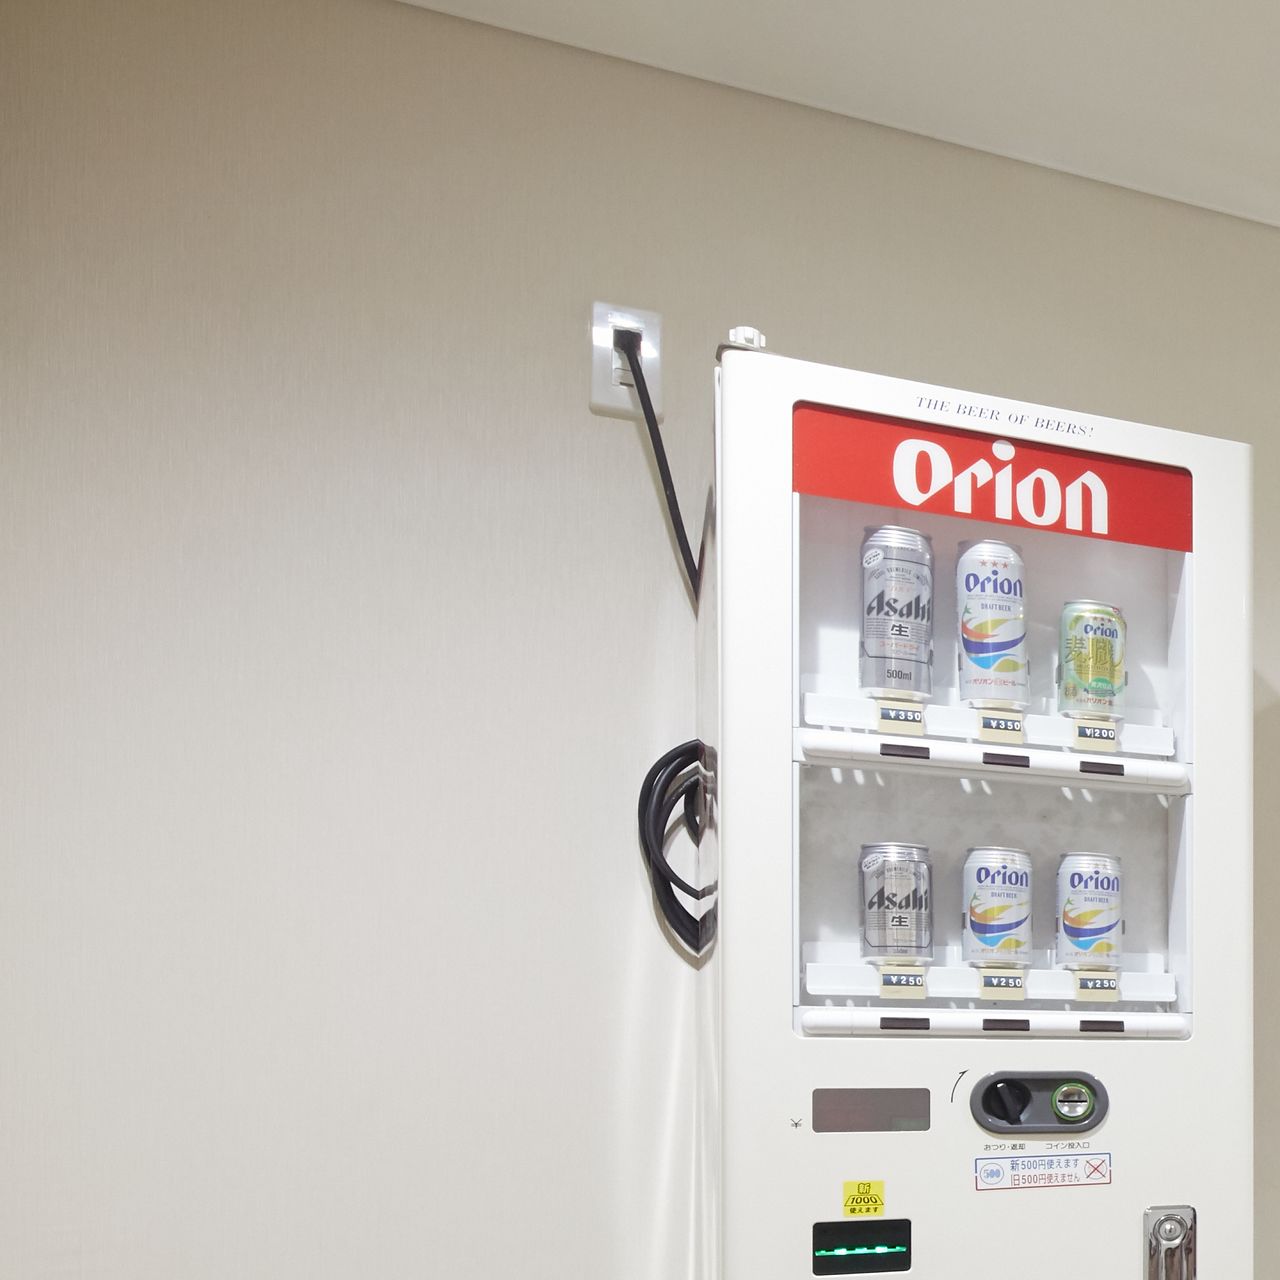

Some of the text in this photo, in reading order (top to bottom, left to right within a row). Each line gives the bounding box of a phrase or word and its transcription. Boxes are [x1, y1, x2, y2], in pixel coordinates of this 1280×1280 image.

[916, 396, 1095, 437] THE BEER OF BEERS!
[893, 438, 1109, 535] Orion
[965, 569, 1023, 598] Orion
[866, 589, 931, 624] Asahi
[981, 602, 1012, 612] DRAFT BEER
[890, 623, 910, 638] 生
[1084, 623, 1119, 639] Orion
[886, 669, 912, 681] 500ml
[889, 710, 921, 721] ¥350
[990, 719, 1021, 731] ¥350
[976, 864, 1029, 888] Orion
[1069, 870, 1120, 892] Orion
[868, 886, 928, 911] Asahi
[990, 891, 1006, 899] DRAFT
[891, 915, 909, 927] 生
[891, 975, 923, 985] ¥250
[991, 978, 1022, 987] ¥250
[1088, 979, 1116, 989] ¥250
[1046, 1141, 1090, 1150] コイン投入口
[1010, 1159, 1080, 1171] 新500円使えます
[1011, 1173, 1080, 1186] 旧500円使えません
[858, 1183, 871, 1195] 新
[850, 1196, 878, 1205] 1000
[849, 1206, 878, 1214] 使えます
